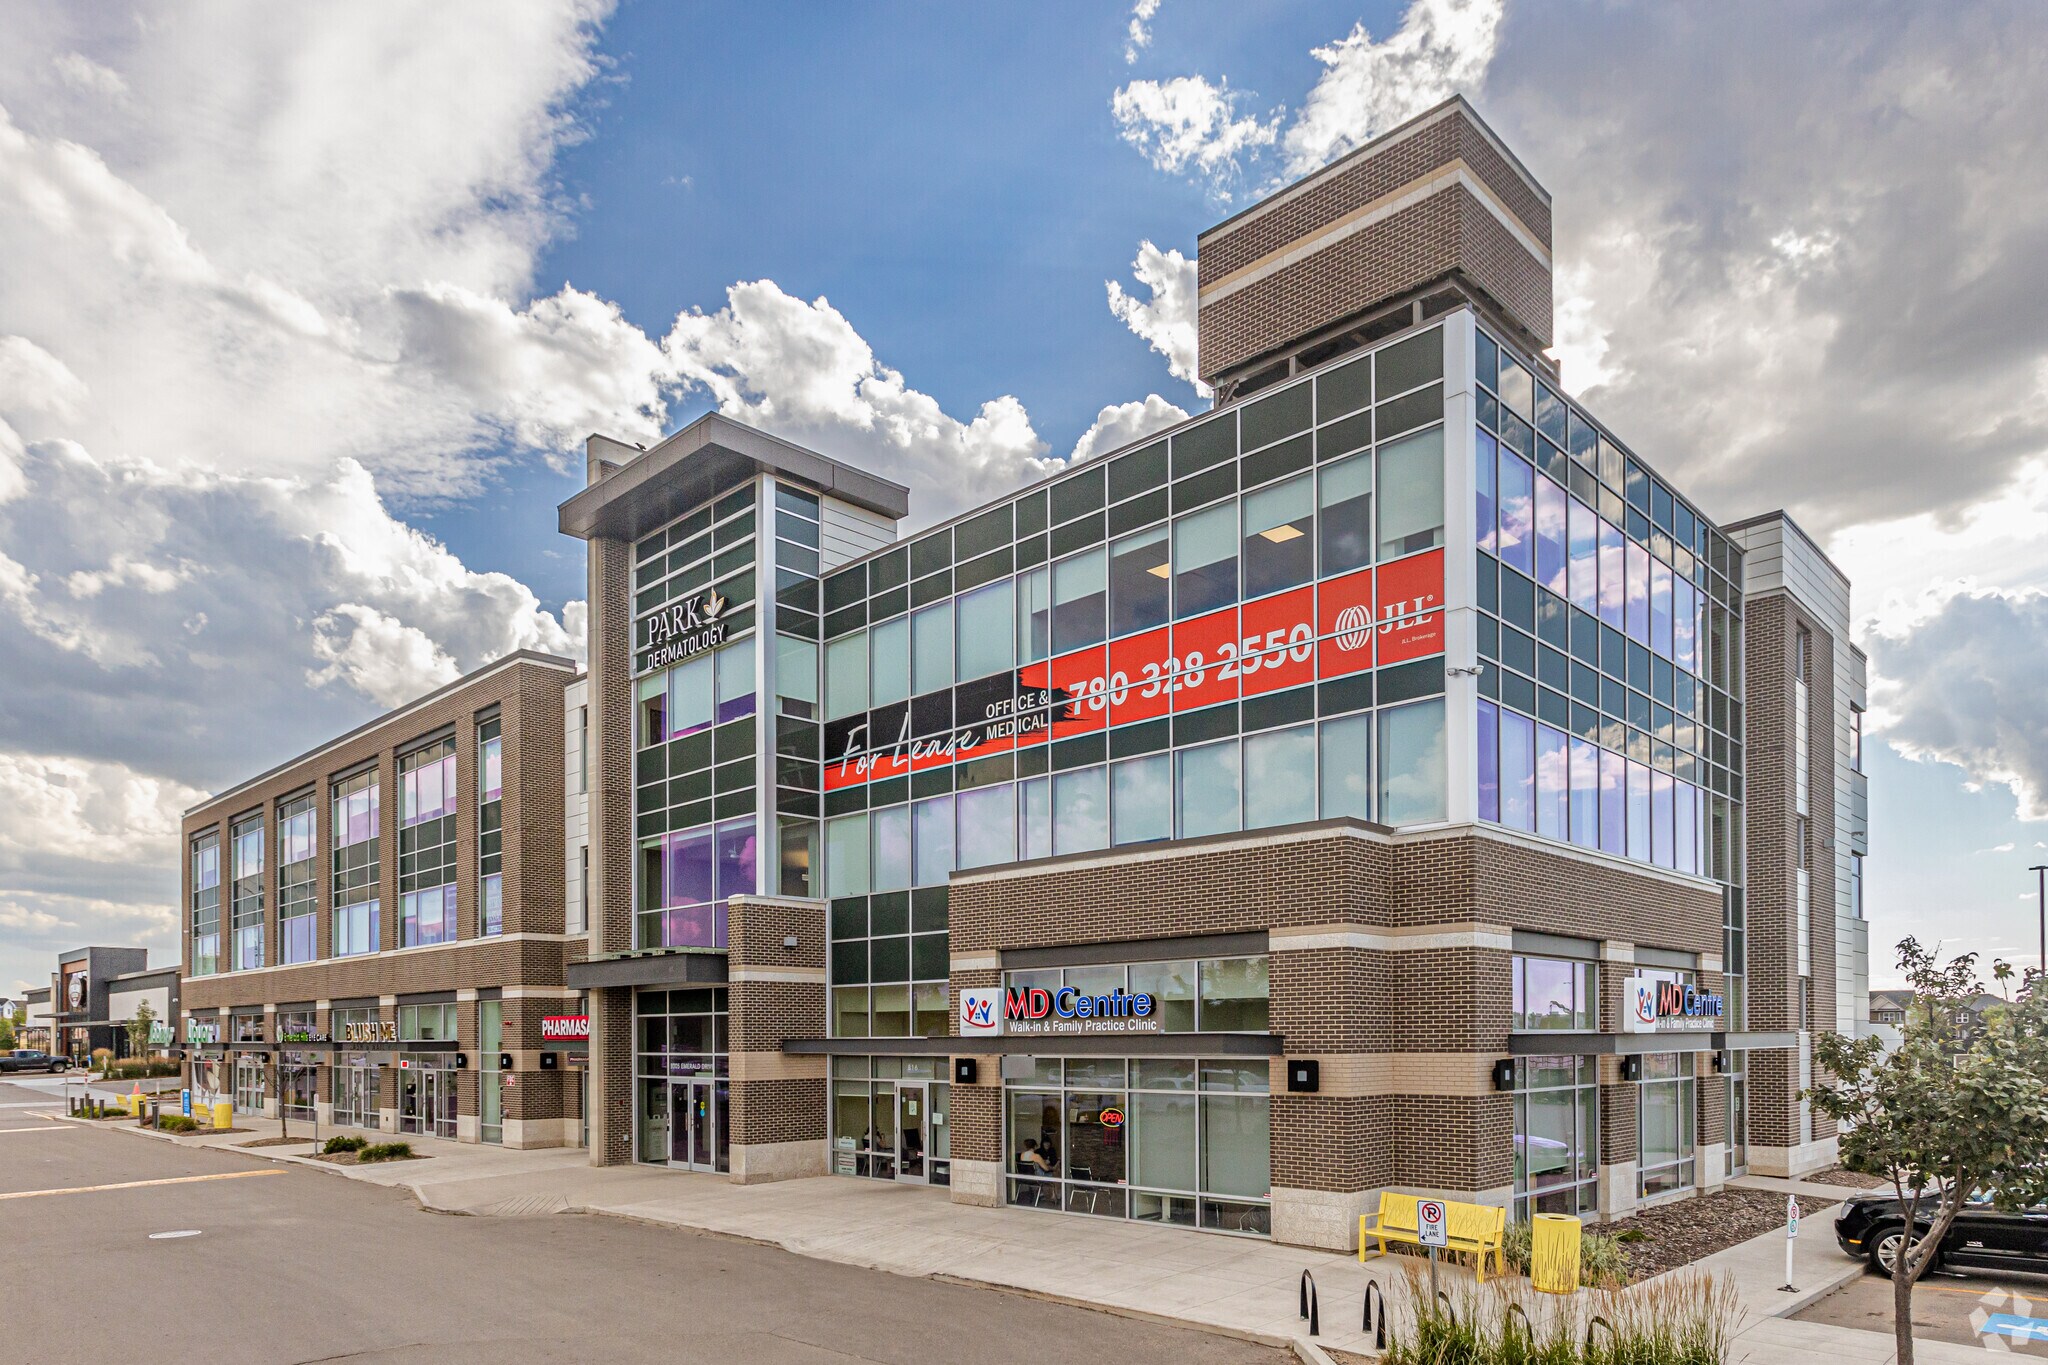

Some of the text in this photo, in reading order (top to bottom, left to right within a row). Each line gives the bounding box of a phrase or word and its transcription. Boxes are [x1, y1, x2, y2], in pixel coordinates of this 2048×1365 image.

[647, 596, 702, 646] PARK
[647, 624, 725, 670] DERMATOLOGY
[1069, 623, 1314, 715] 780 328 2550
[986, 690, 1049, 718] OFFICE &
[986, 714, 1049, 740] MEDICAL
[840, 712, 981, 777] For Lease
[1004, 986, 1152, 1019] MD Centre
[1659, 984, 1723, 1016] MD Centre
[345, 1021, 397, 1043] BLUSH ME
[1009, 1018, 1157, 1034] Walk-in & Family Practice Clinic
[1101, 1111, 1123, 1124] OPEN
